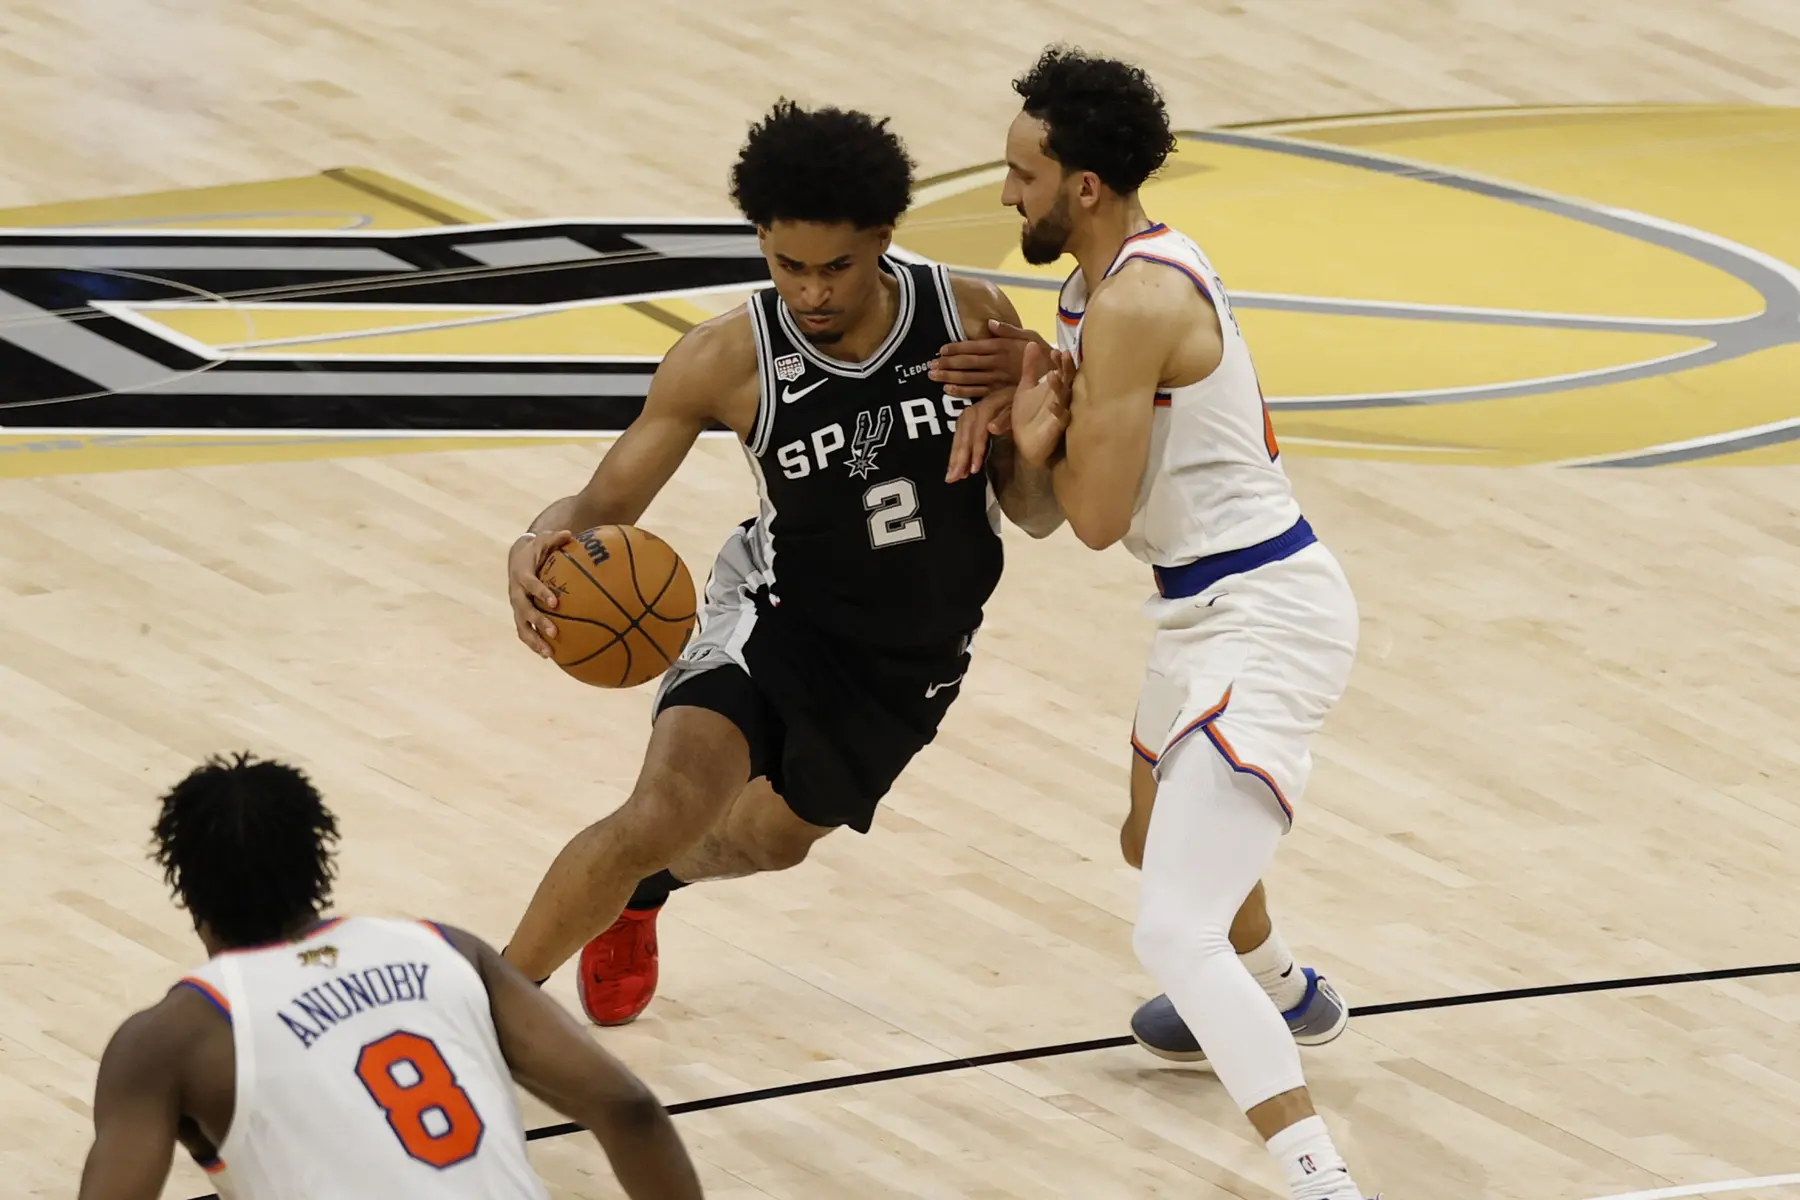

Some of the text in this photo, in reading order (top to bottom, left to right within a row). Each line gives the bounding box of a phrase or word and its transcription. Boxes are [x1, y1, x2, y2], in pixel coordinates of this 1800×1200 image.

[777, 357, 799, 367] USA
[862, 477, 926, 550] 2
[277, 962, 430, 1050] ANUNOBY
[354, 1029, 485, 1171] 8
